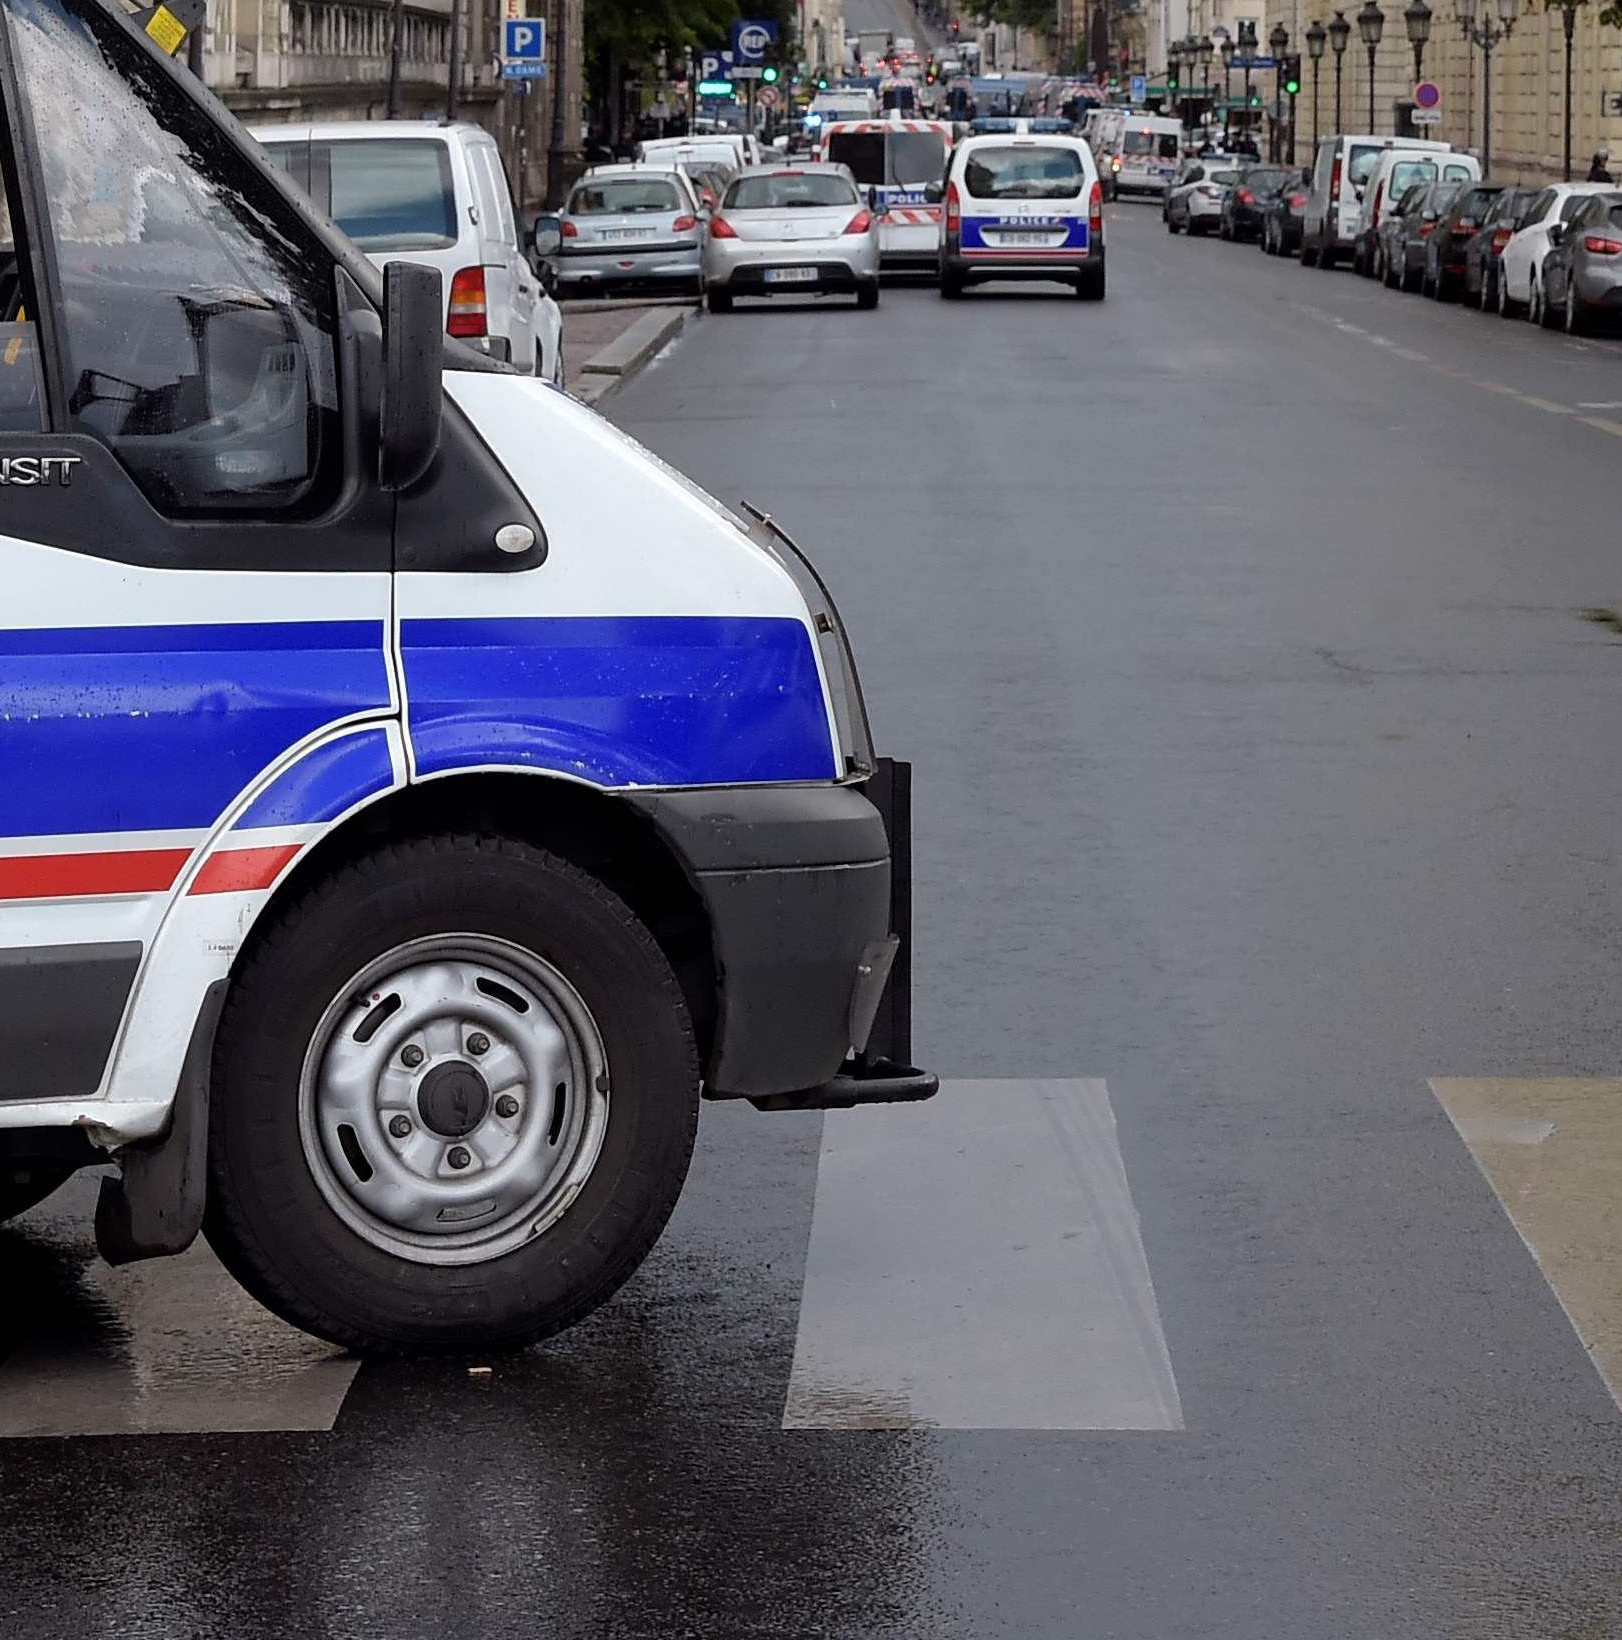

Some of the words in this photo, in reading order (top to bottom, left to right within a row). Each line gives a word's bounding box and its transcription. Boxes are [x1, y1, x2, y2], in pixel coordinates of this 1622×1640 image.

[514, 27, 533, 52] P
[702, 57, 719, 79] P
[888, 193, 928, 204] POLIC
[999, 216, 1049, 225] POLICE
